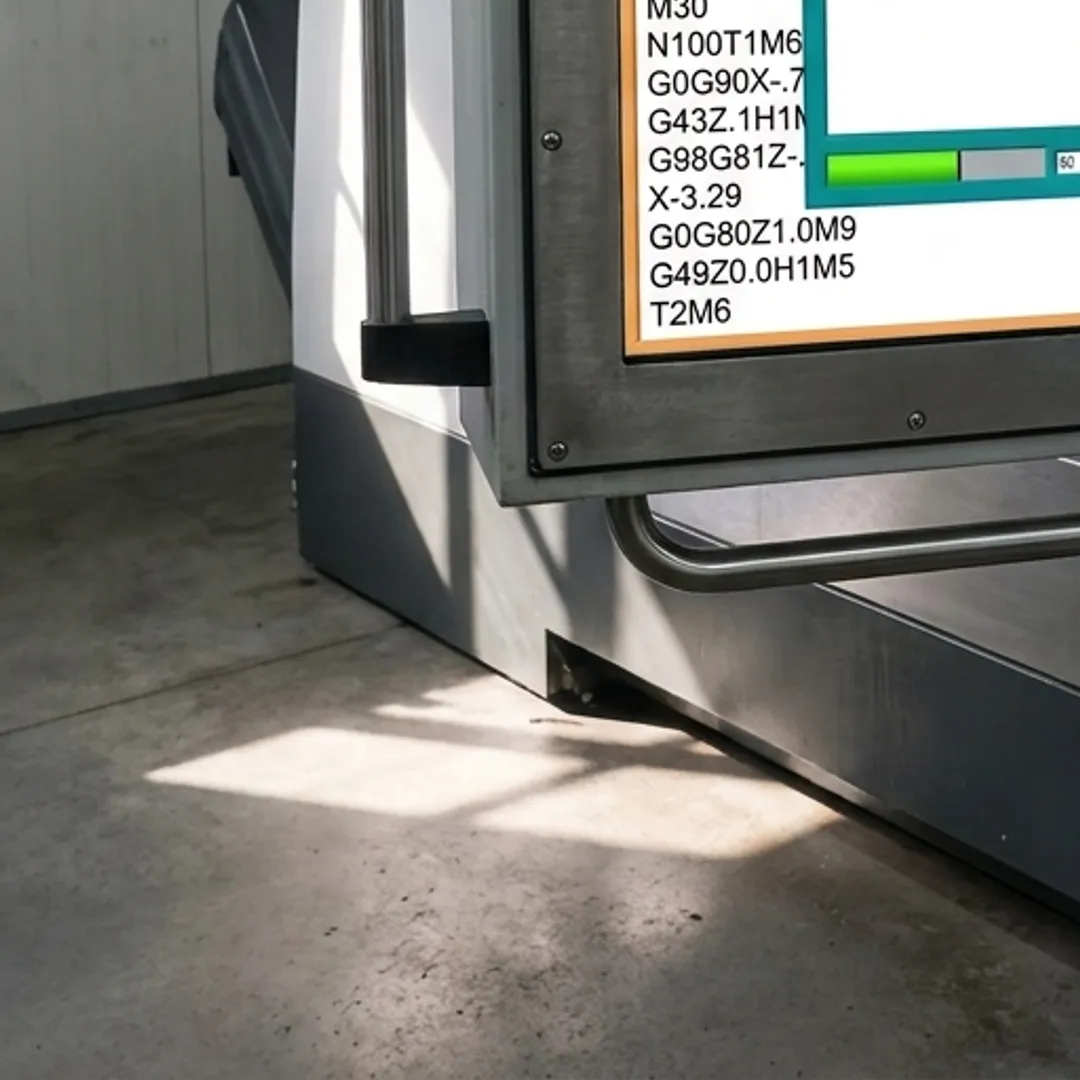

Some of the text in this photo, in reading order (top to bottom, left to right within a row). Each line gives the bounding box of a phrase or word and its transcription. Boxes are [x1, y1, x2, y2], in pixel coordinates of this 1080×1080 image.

[647, 29, 803, 58] N100T1M6
[648, 66, 805, 96] G0G90X-.7
[648, 143, 805, 172] G98G81Z-.
[648, 183, 742, 212] X-3.29
[649, 215, 856, 250] G0G80Z1.0M9
[650, 253, 855, 288] G49Z0.0H1M5
[650, 298, 731, 326] T2M6
